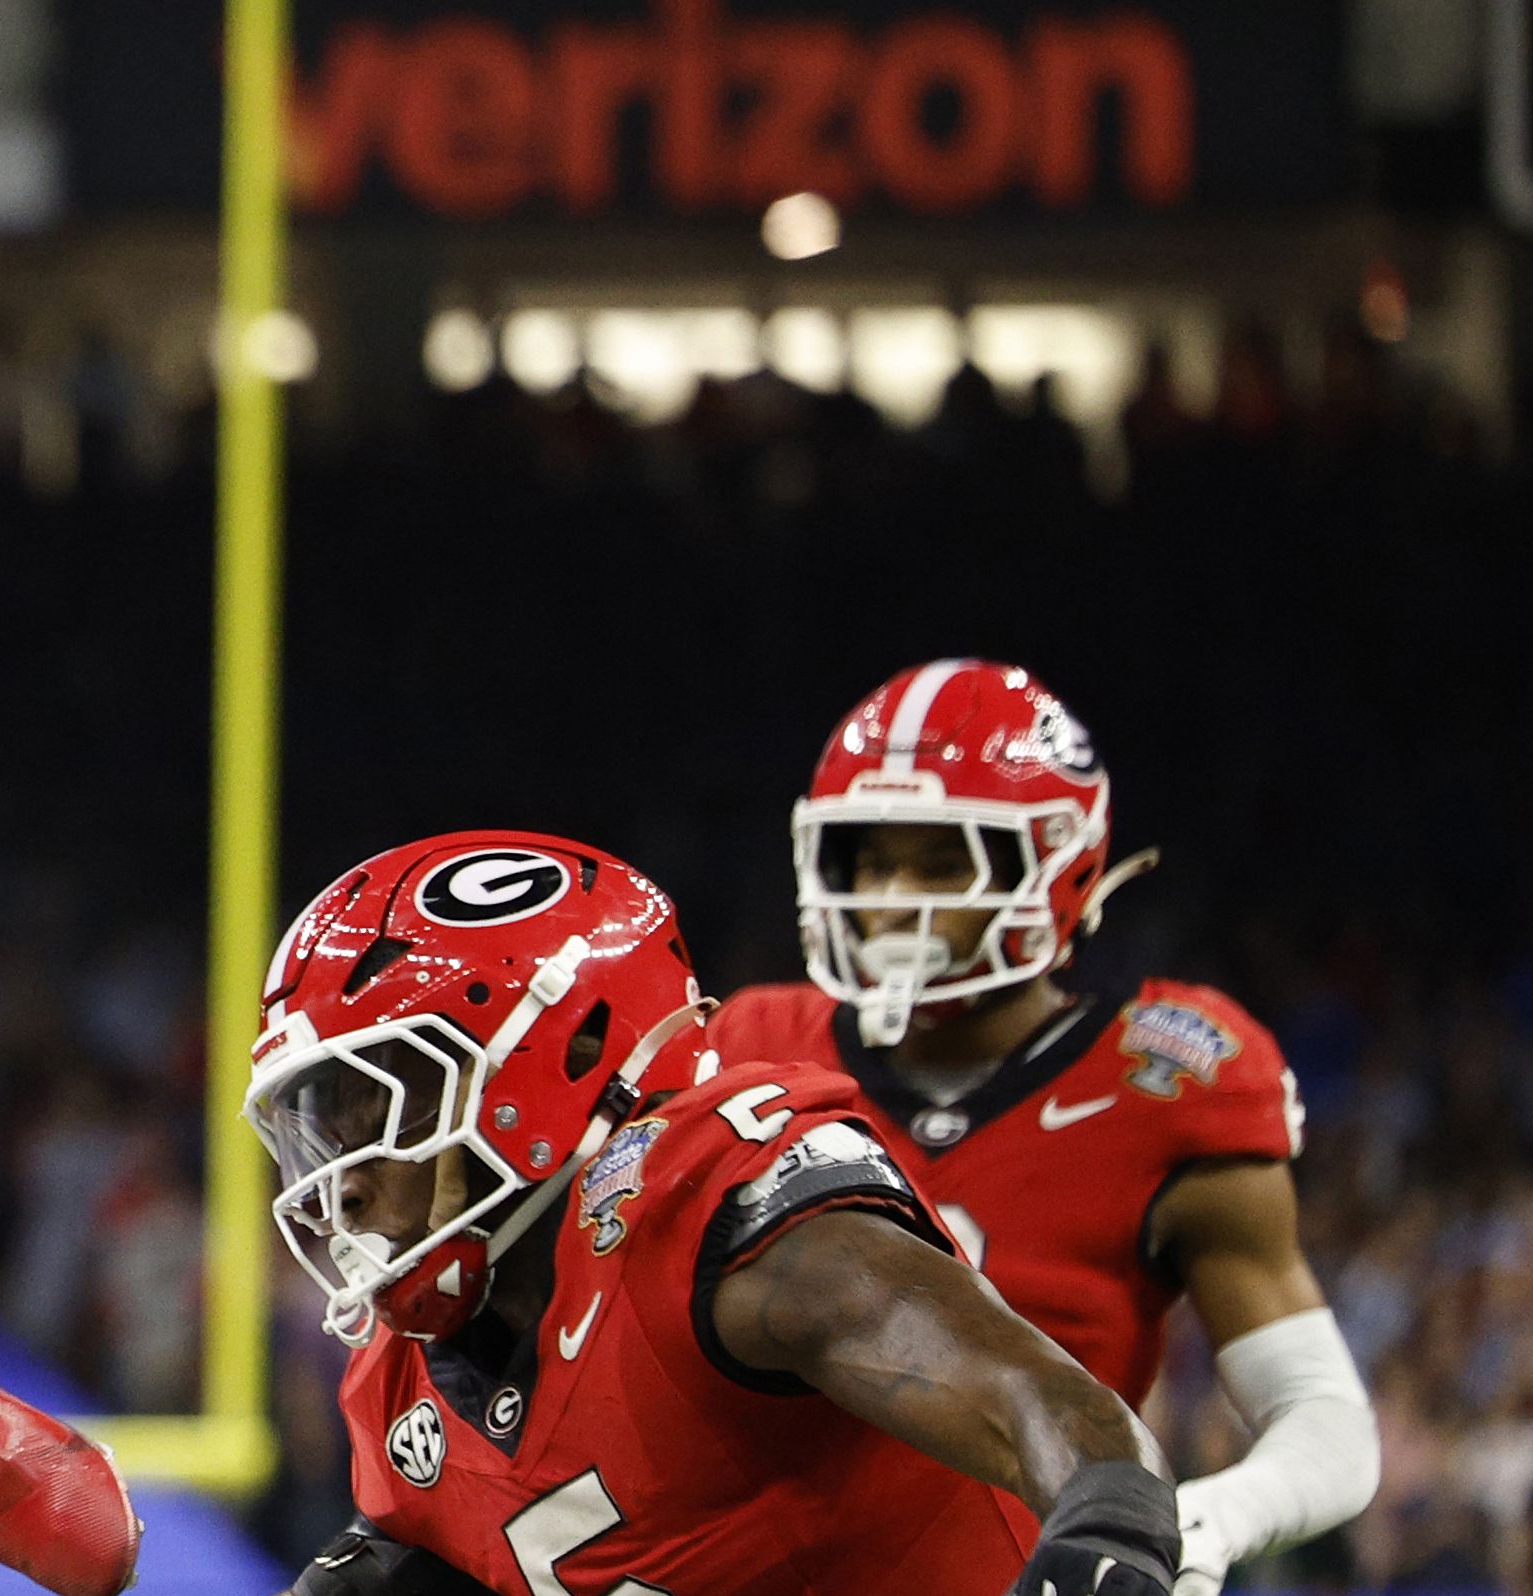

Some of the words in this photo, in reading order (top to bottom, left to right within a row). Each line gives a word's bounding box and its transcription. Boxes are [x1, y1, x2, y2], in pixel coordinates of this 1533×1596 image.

[425, 852, 565, 918] G
[392, 1404, 441, 1480] SEC
[489, 1389, 523, 1433] G
